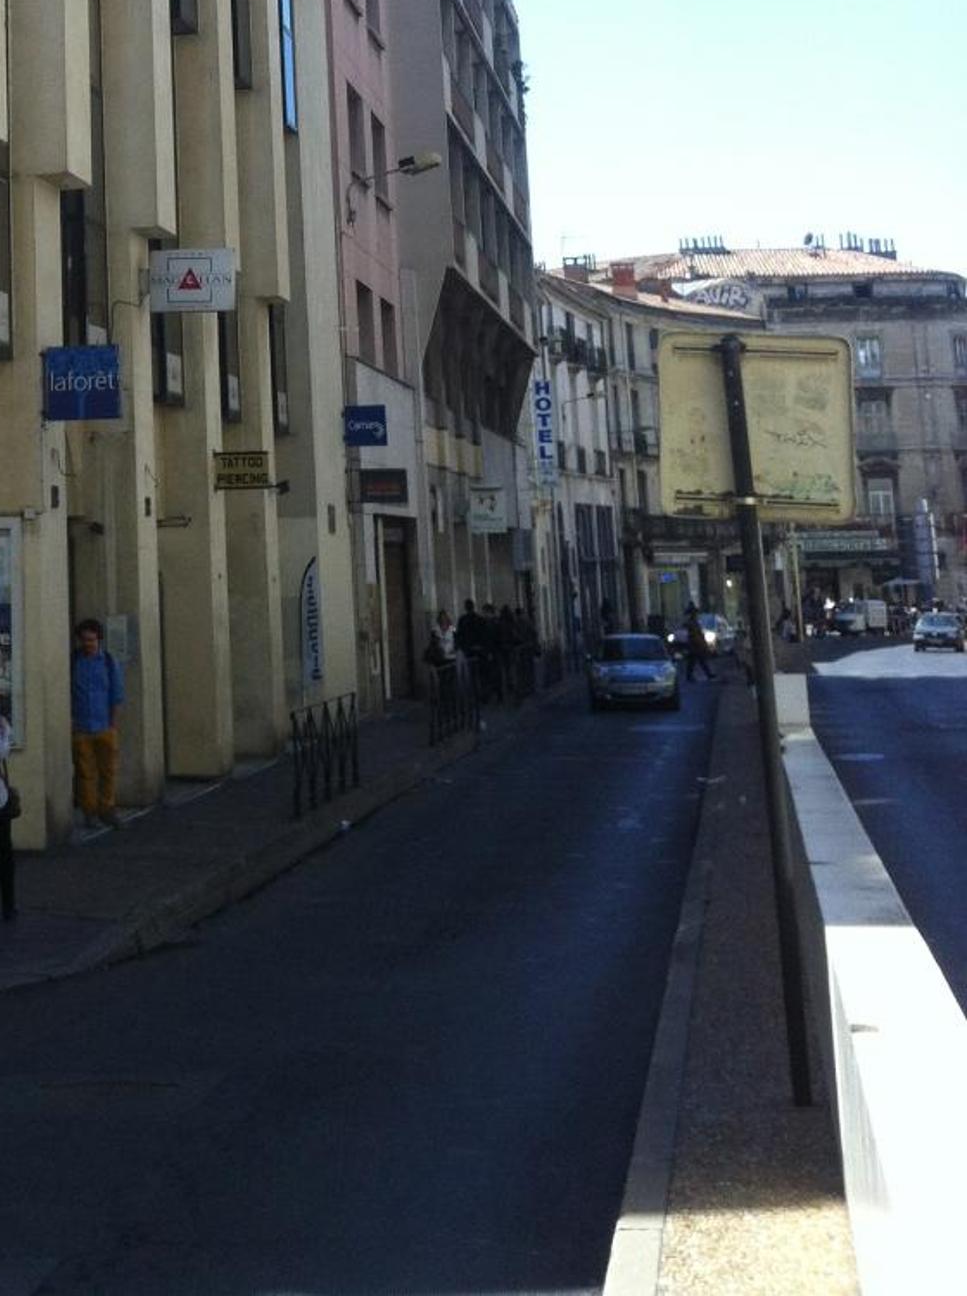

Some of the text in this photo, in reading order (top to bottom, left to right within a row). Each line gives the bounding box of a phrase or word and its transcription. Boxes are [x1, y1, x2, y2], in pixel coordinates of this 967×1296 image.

[50, 369, 115, 392] laforêt
[534, 381, 553, 460] HOTEL
[220, 456, 263, 469] TATTOO
[217, 473, 269, 485] PIERCING
